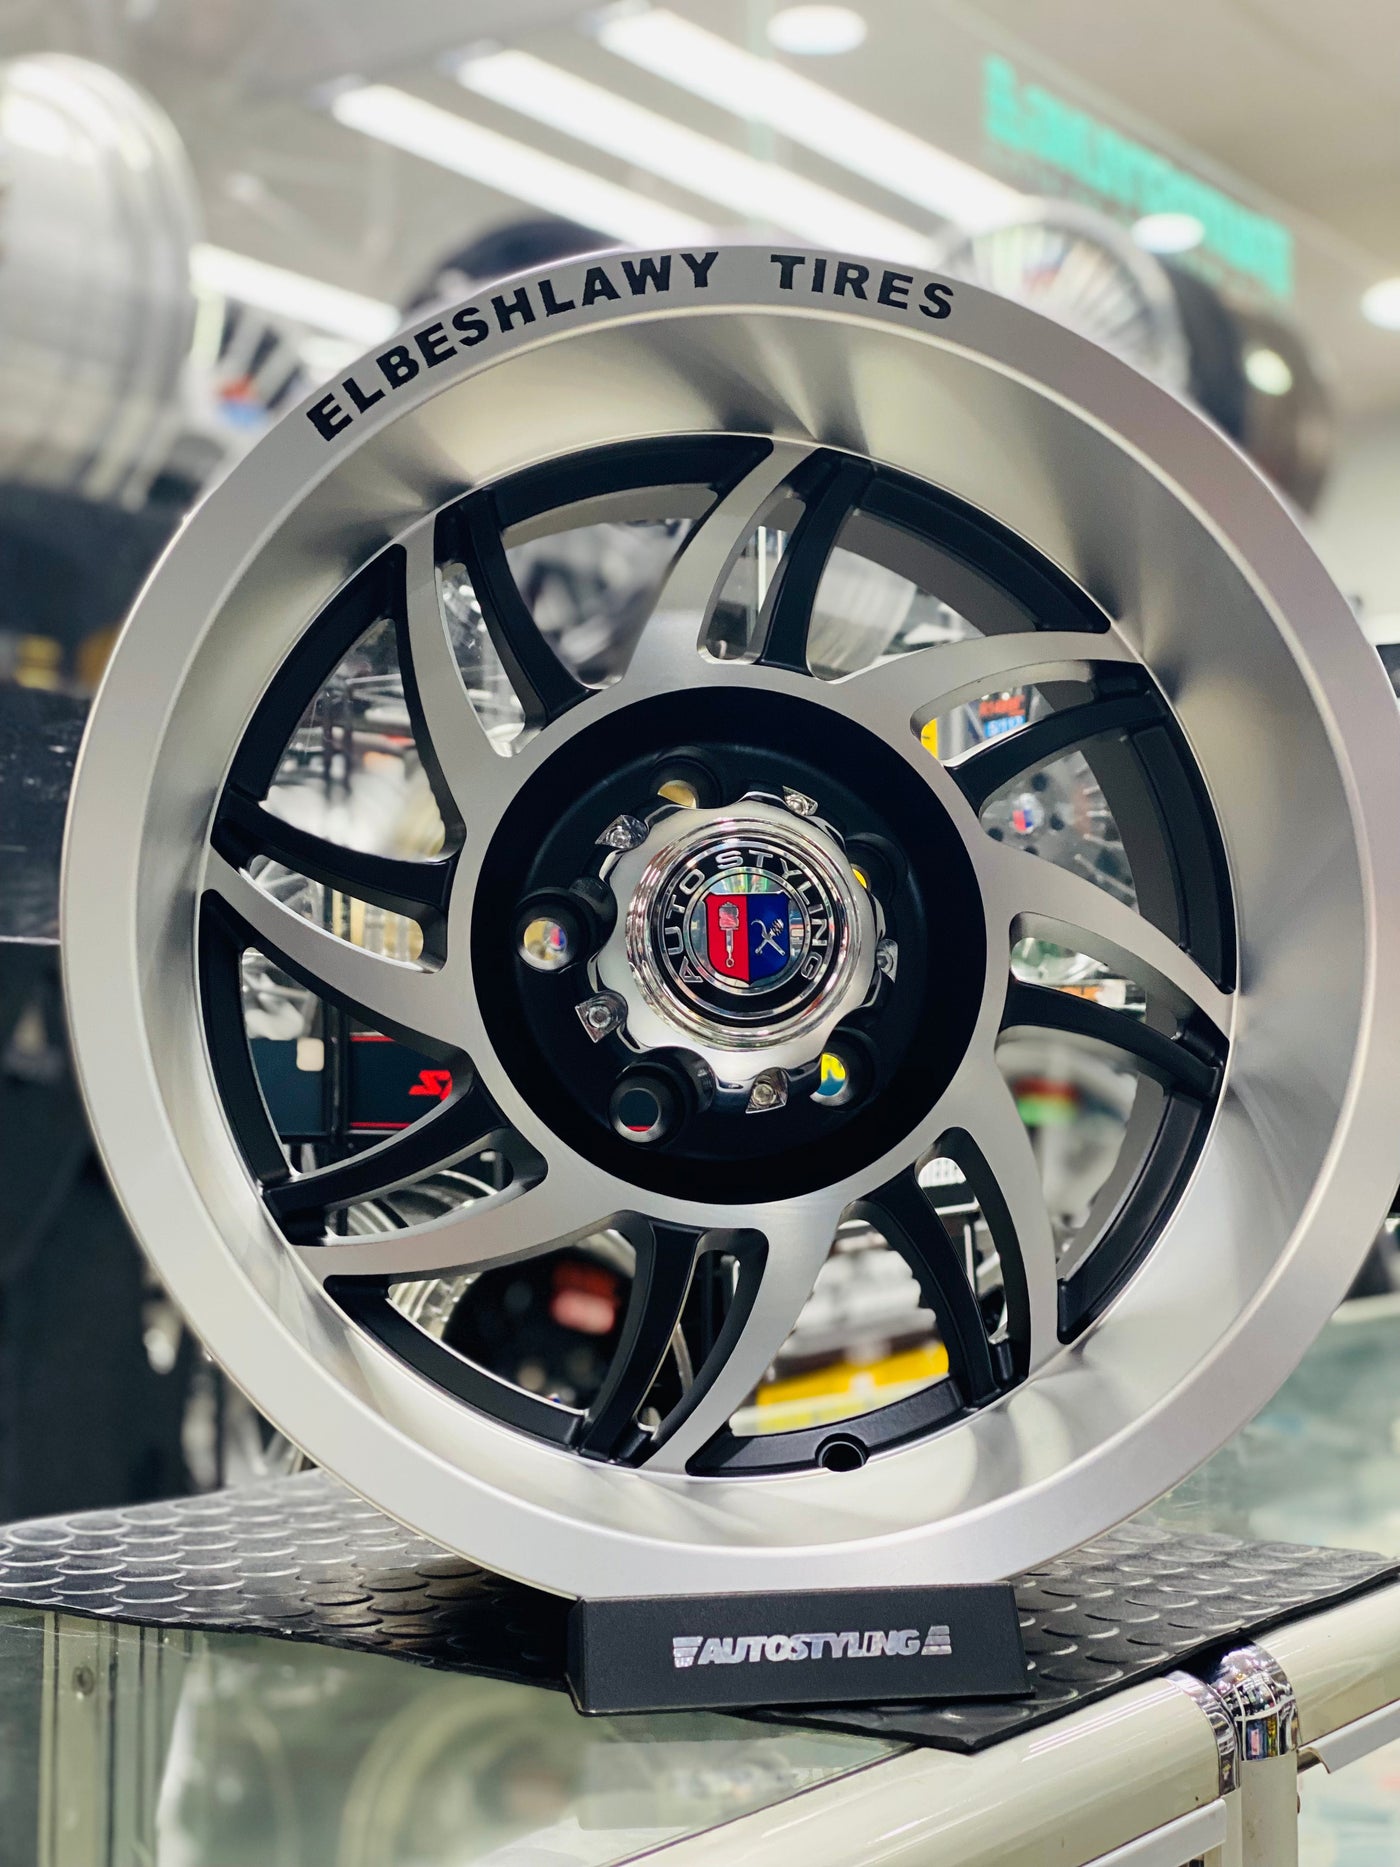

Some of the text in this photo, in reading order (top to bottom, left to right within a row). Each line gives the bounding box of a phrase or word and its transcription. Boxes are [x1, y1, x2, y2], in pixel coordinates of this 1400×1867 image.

[306, 251, 954, 441] ELBESHLAWY TIRES
[698, 1629, 921, 1664] AUTOSTYLING
